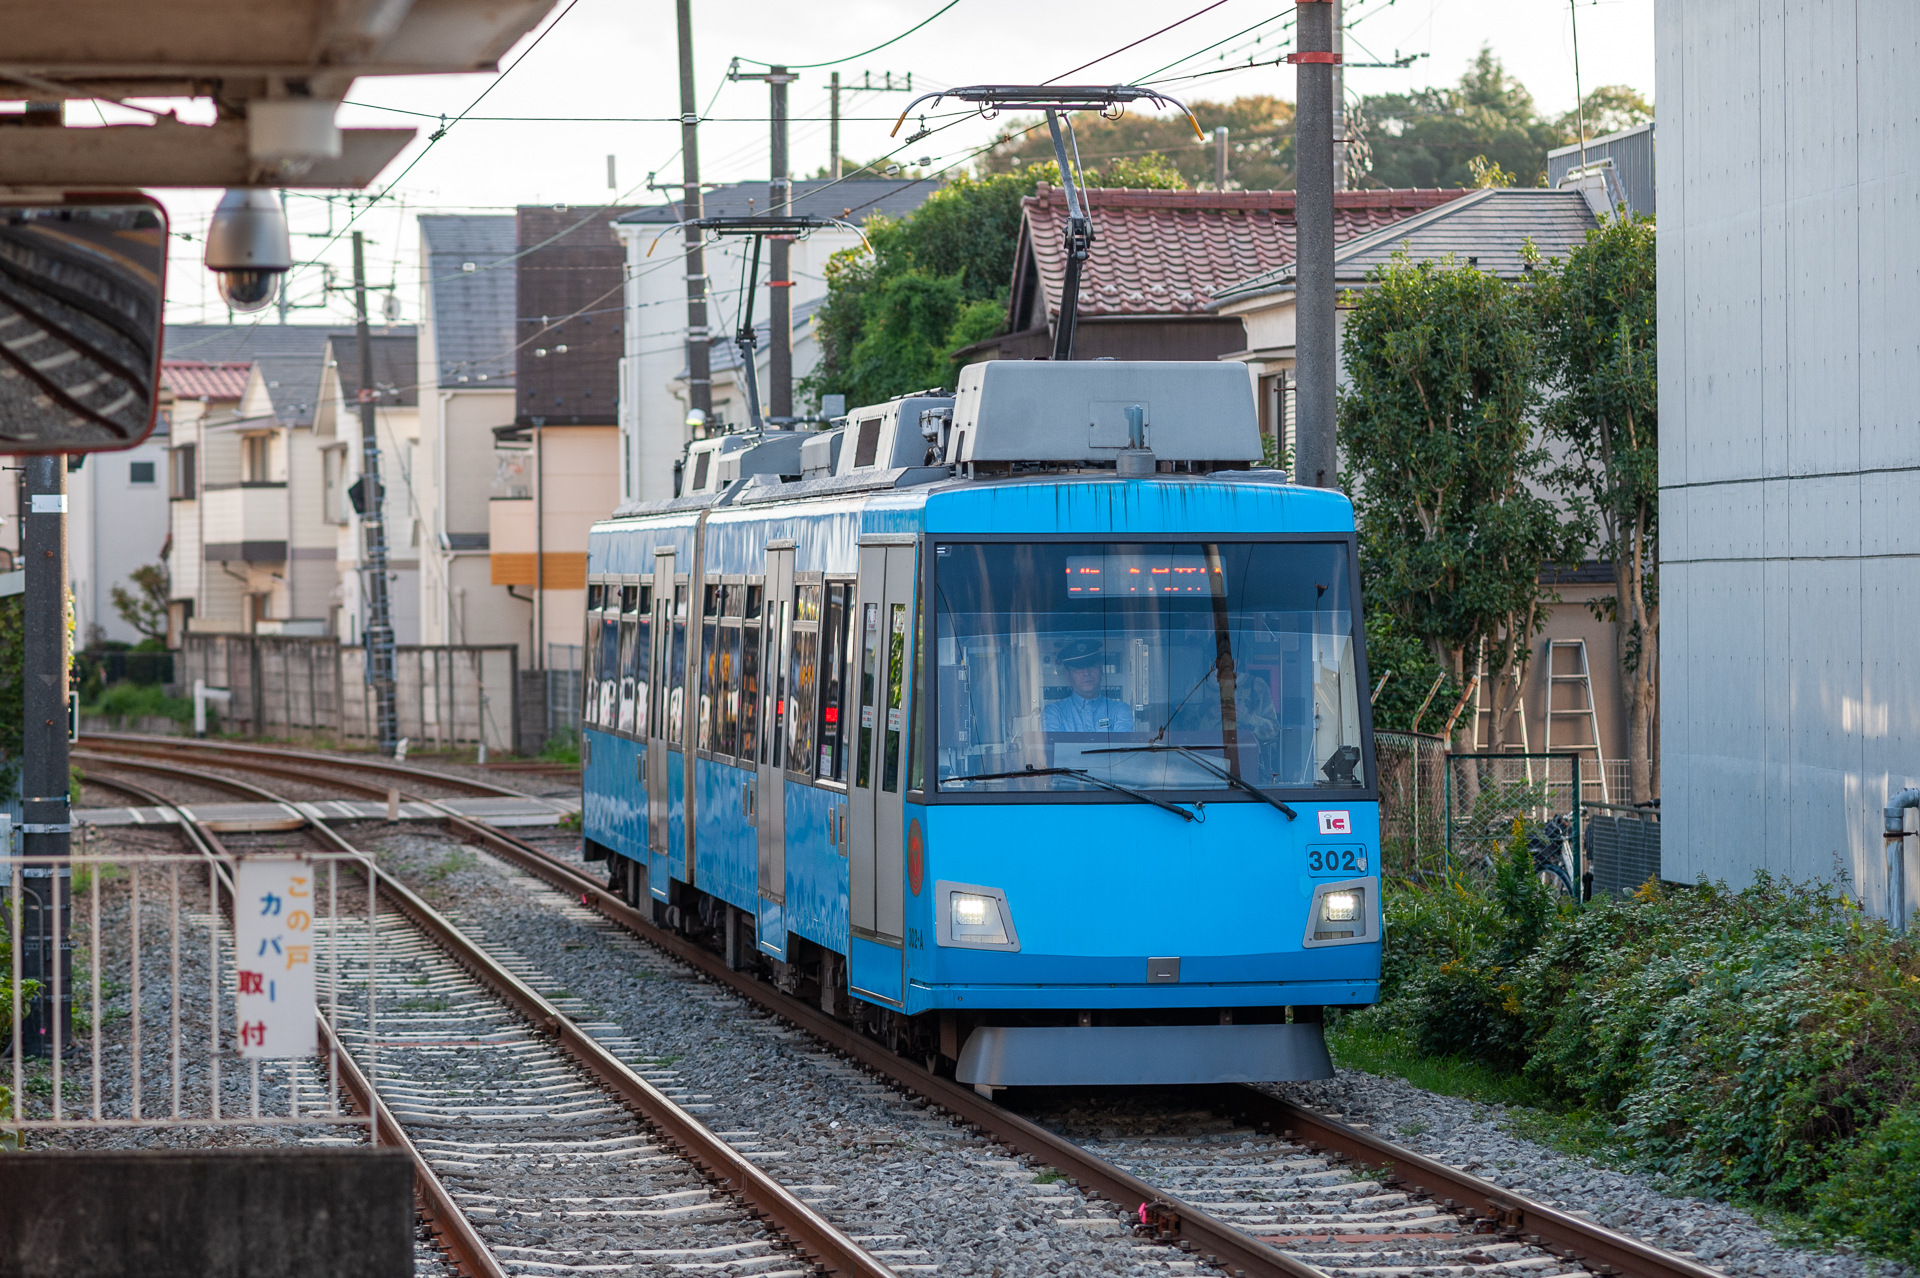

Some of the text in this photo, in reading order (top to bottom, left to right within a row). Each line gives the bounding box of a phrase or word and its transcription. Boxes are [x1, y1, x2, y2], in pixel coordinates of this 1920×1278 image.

[1309, 850, 1356, 871] 302
[258, 892, 283, 1003] カバー
[284, 876, 311, 971] この戸
[238, 969, 267, 1047] 取付
